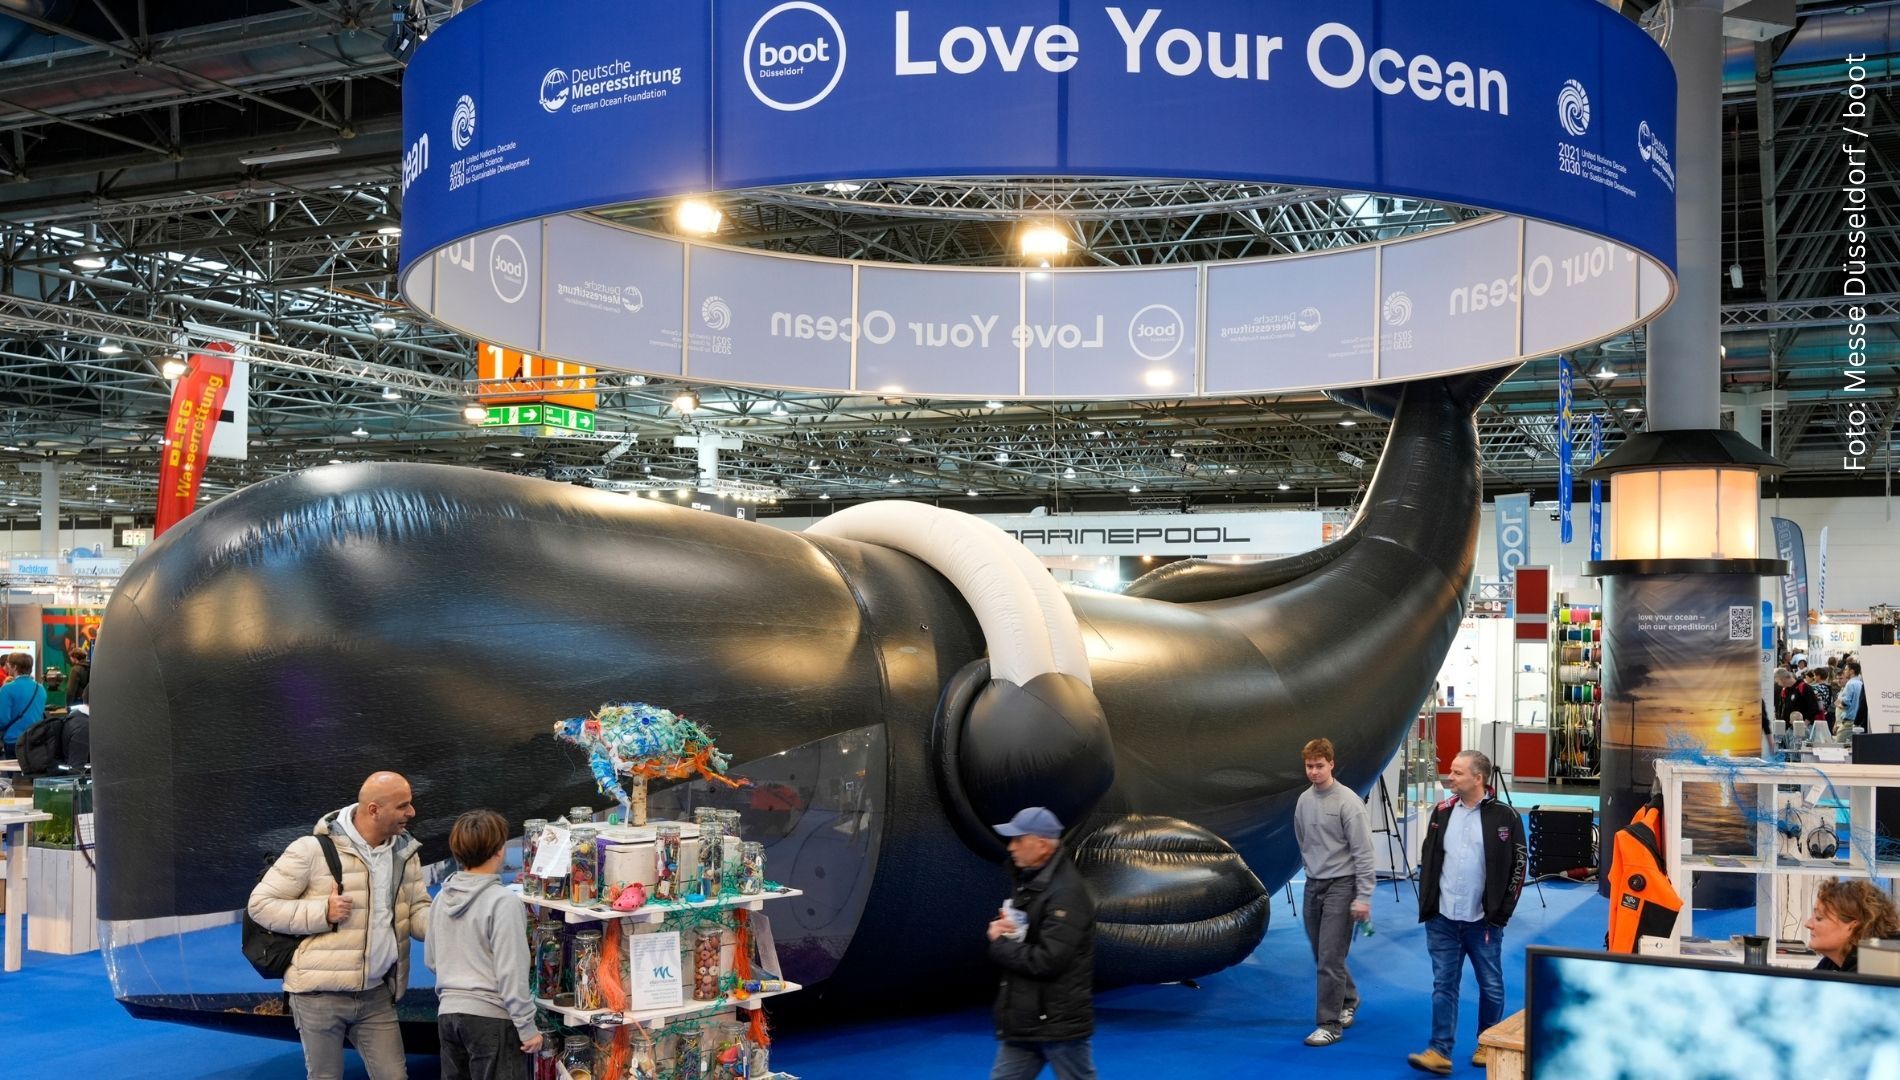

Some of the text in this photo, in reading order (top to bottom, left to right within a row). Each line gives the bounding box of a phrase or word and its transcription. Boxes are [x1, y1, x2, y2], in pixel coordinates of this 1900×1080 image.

[760, 37, 830, 67] boot
[895, 7, 1508, 116] Love Your Ocean
[572, 59, 631, 84] Deutsche
[572, 67, 682, 99] Meeresstiftung
[760, 66, 804, 78] Düsseldorf
[571, 88, 667, 114] German Ocean Foundation
[466, 141, 517, 165] United Nations Decade
[1558, 142, 1580, 161] 2021
[402, 132, 429, 197] ean
[450, 158, 465, 178] 2021
[471, 162, 484, 173] Ocean
[485, 155, 504, 168] Science
[472, 167, 497, 184] Sustainable
[497, 157, 530, 174] Development
[1559, 157, 1580, 176] 2030
[449, 172, 465, 191] 2030
[169, 399, 193, 467] DLRG
[176, 375, 224, 497] Wasserrettung
[1638, 613, 1653, 621] love
[1654, 614, 1672, 622] your
[1638, 623, 1652, 632] join
[1668, 623, 1717, 632] expeditions!
